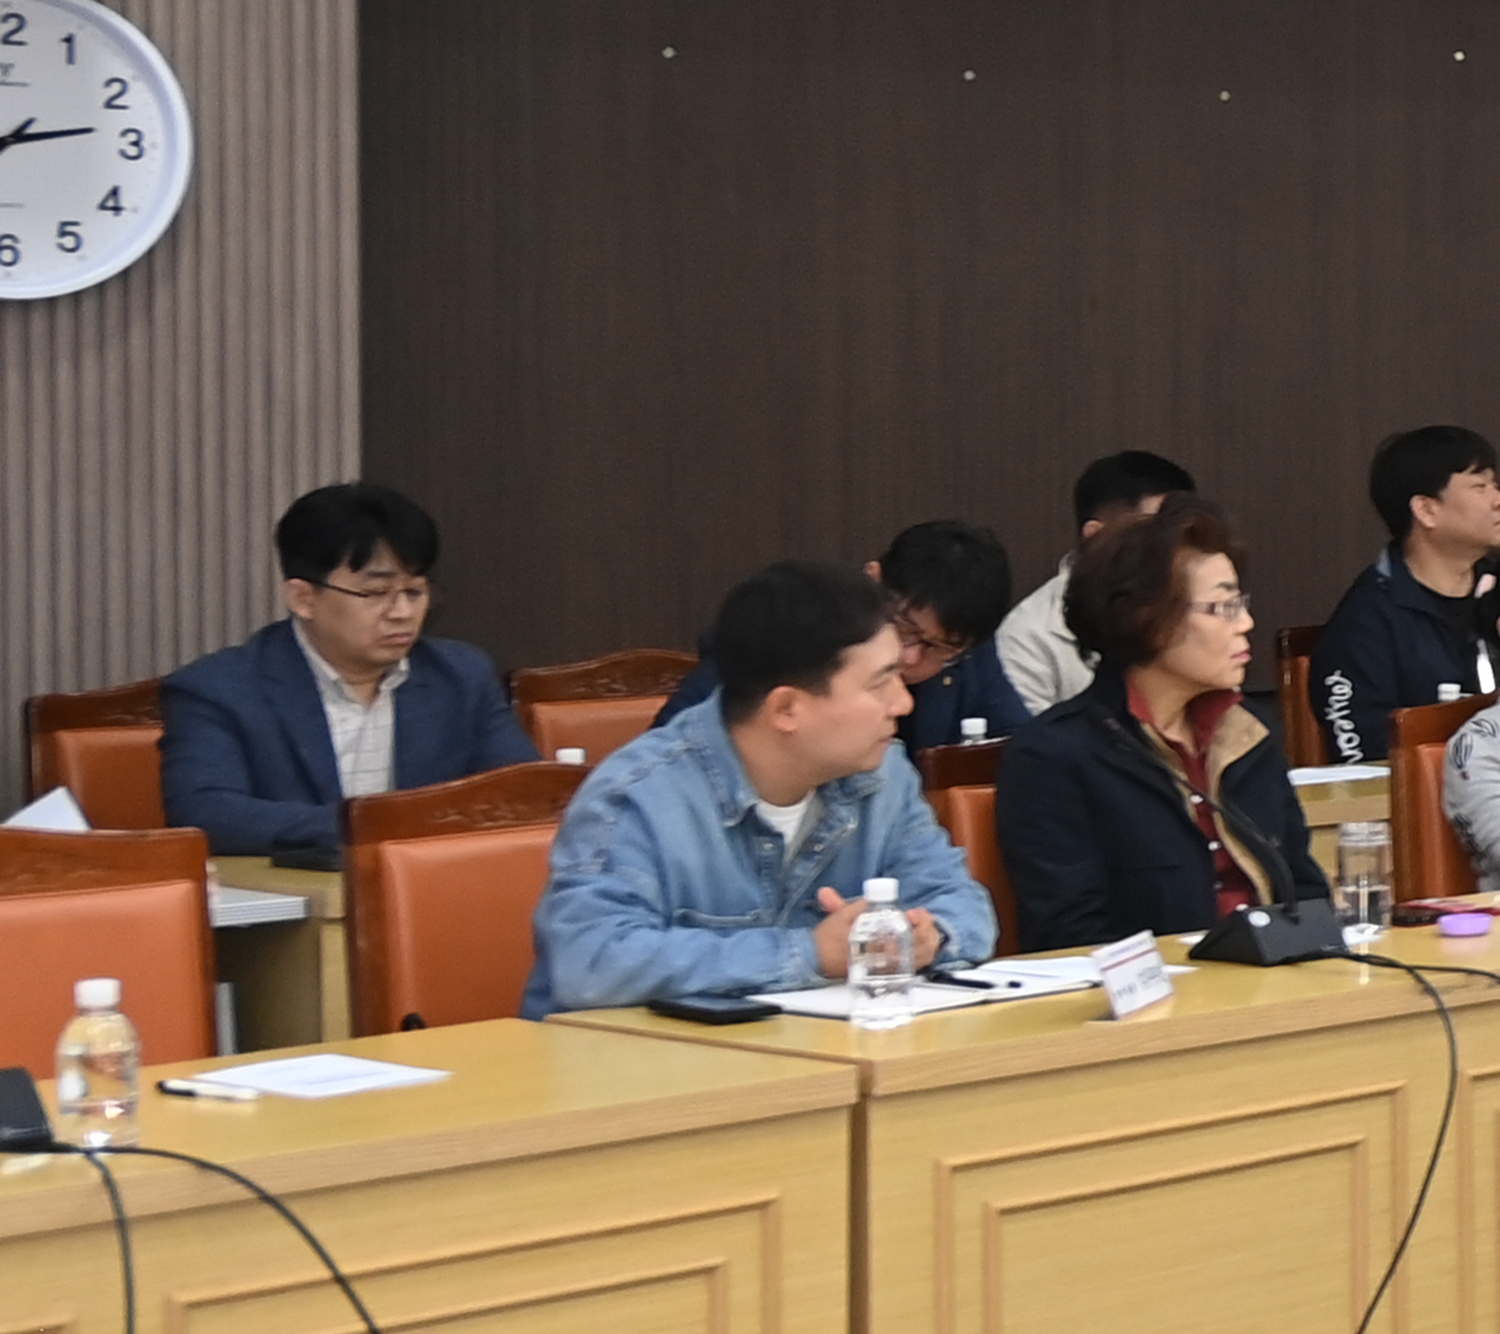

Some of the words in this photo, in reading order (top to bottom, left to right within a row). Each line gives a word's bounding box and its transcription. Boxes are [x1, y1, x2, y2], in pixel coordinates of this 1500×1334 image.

[60, 33, 76, 65] 1
[102, 77, 130, 110] 2
[118, 128, 145, 160] 3
[96, 185, 126, 217] 4
[56, 221, 83, 253] 5
